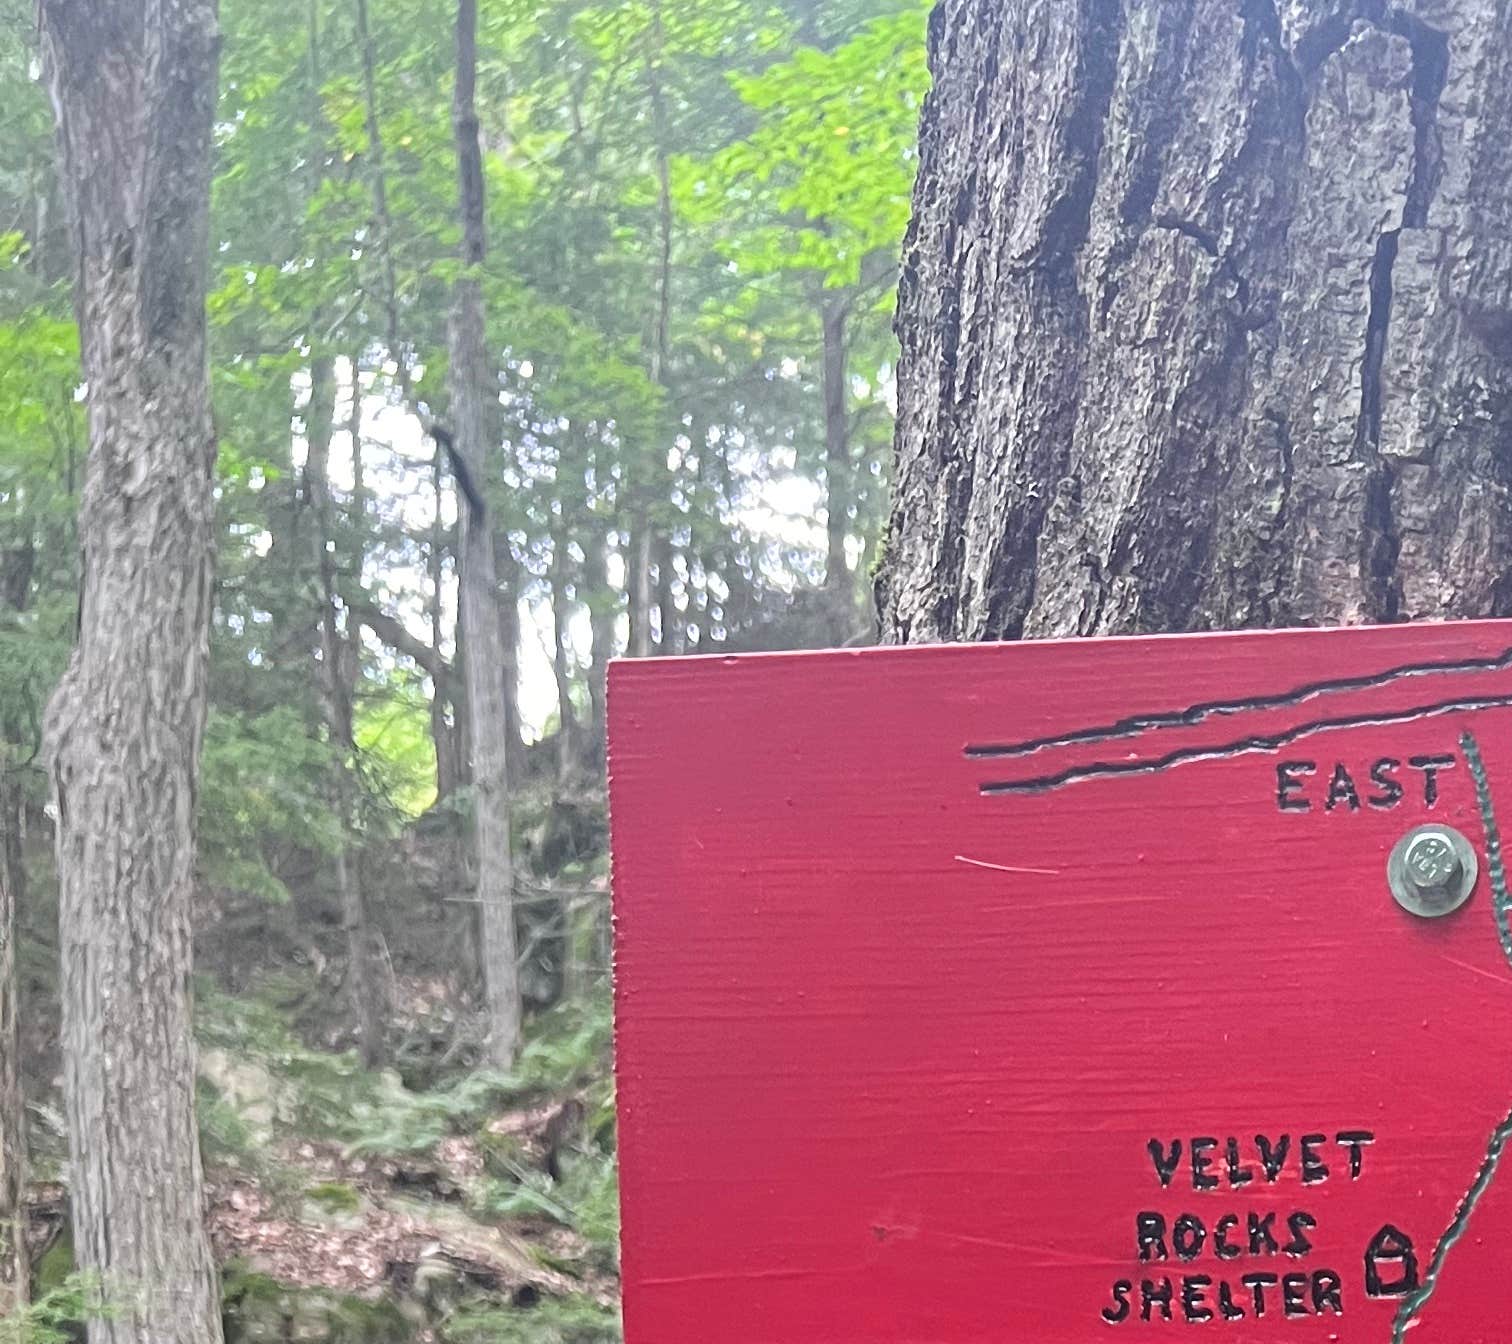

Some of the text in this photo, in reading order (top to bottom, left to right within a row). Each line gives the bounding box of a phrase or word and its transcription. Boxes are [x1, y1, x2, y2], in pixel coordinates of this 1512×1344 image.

[1275, 754, 1456, 814] EAST
[1147, 1130, 1375, 1189] VELVET
[1136, 1211, 1318, 1262] ROCKS
[1102, 1269, 1342, 1323] SHELTER
